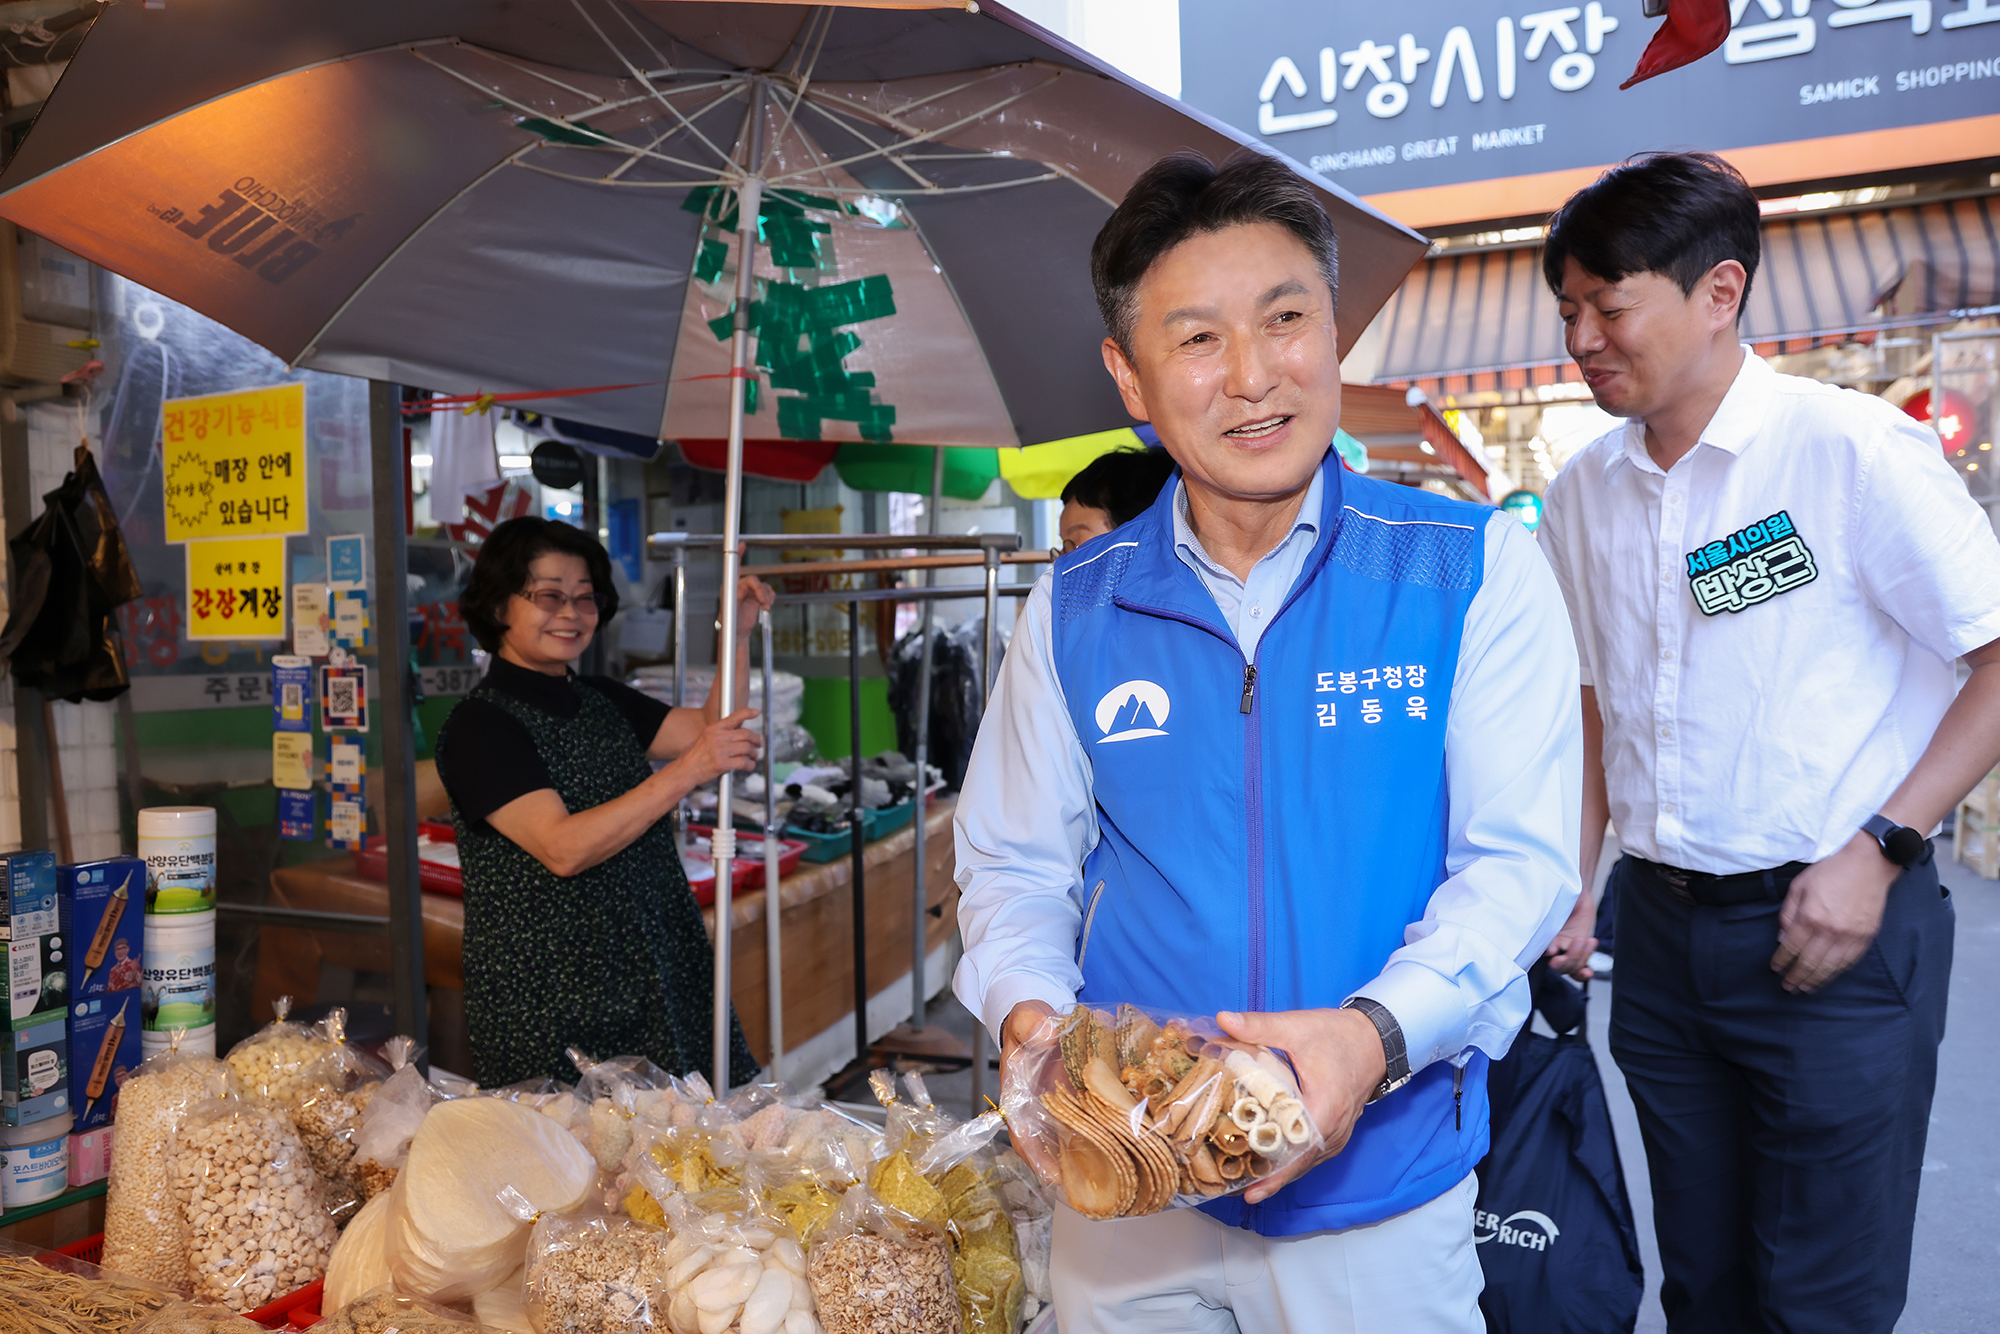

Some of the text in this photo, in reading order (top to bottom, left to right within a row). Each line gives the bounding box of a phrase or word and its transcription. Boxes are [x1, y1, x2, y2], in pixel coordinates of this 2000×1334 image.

[1258, 1, 1619, 135] 신창시장
[1799, 75, 1880, 106] SAMICK
[1309, 124, 1547, 174] SINCHANG GREAT MARKET
[214, 452, 291, 483] 매장 안에
[219, 495, 290, 526] 있습니다
[1687, 511, 1795, 576] 서울시의원
[1696, 540, 1812, 611] 박상근
[192, 586, 282, 619] 간장게장
[1315, 665, 1427, 694] 도봉구청장
[1473, 1207, 1547, 1252] ER RICH
